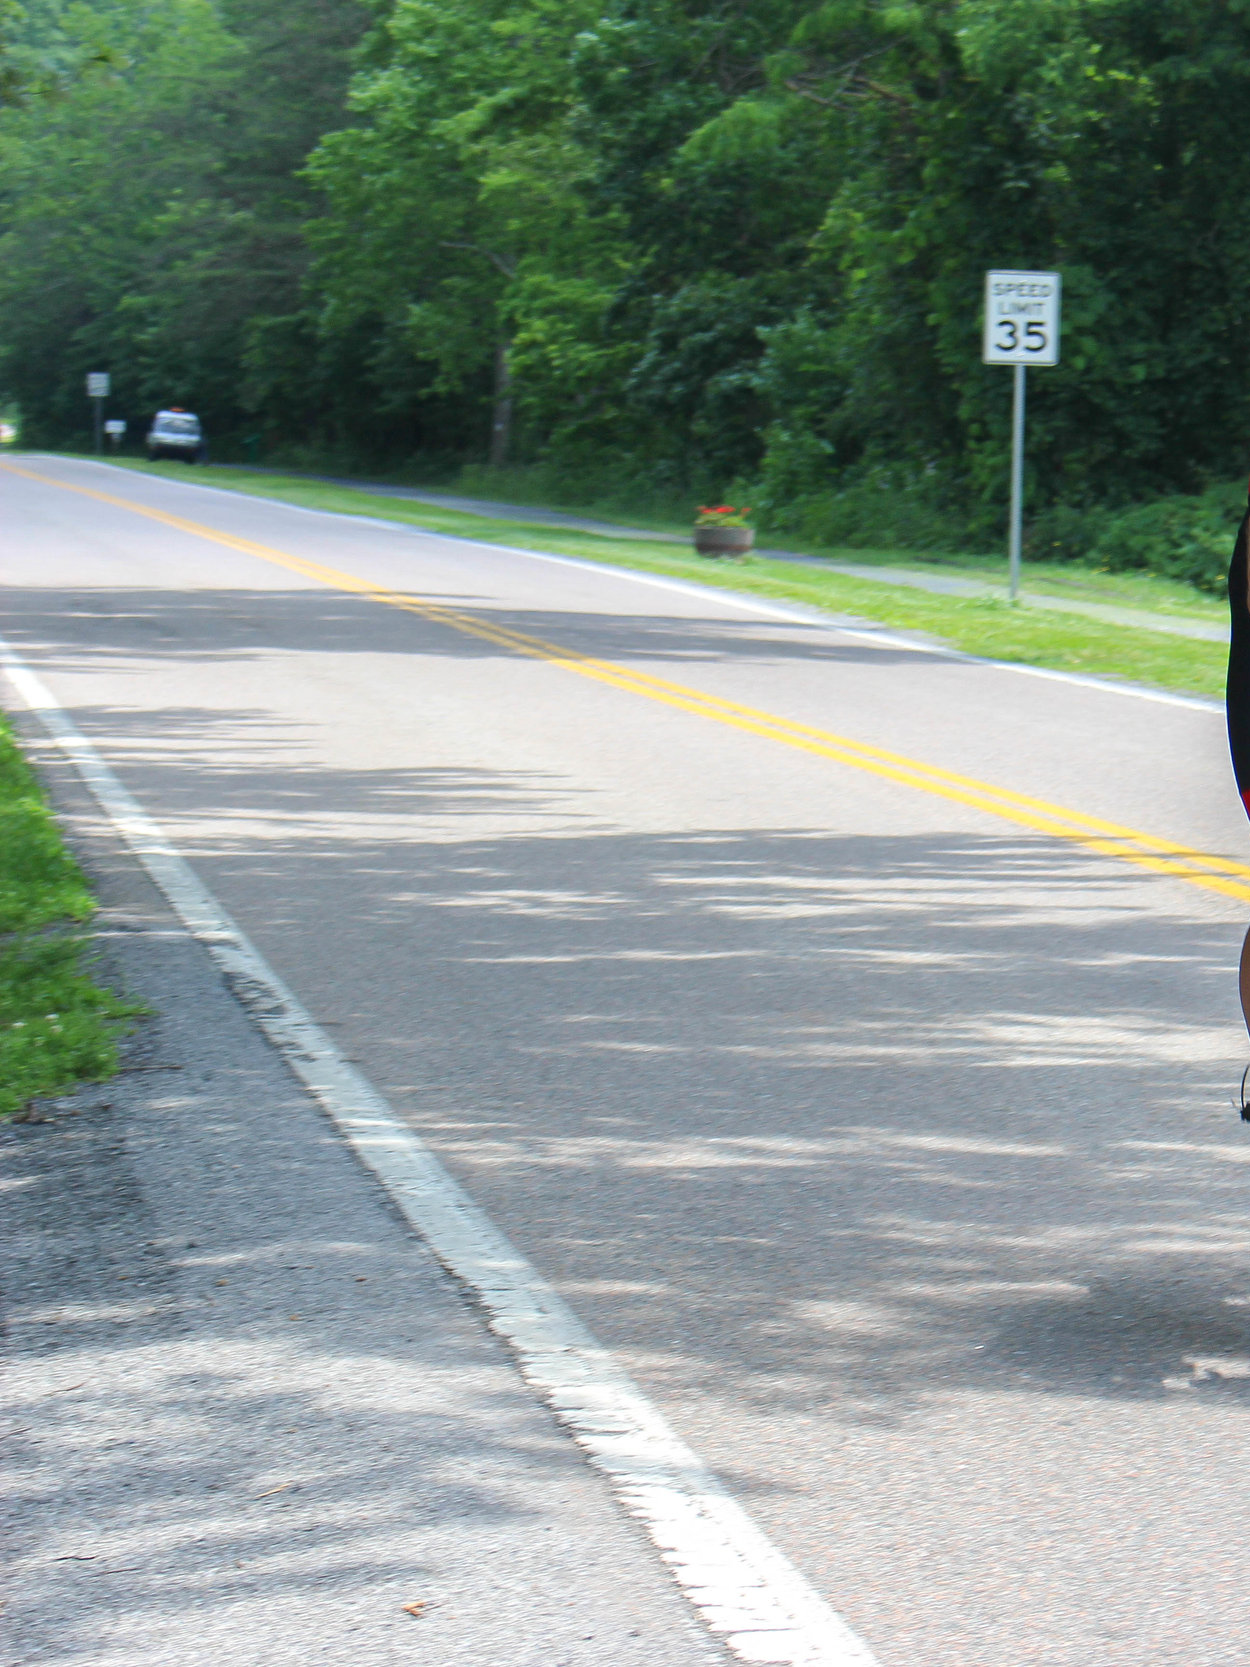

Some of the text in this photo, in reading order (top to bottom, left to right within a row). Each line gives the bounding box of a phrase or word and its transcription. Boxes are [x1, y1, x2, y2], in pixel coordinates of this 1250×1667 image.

[993, 283, 1050, 297] SPEED
[998, 302, 1046, 316] LIMIT
[995, 321, 1046, 351] 35
